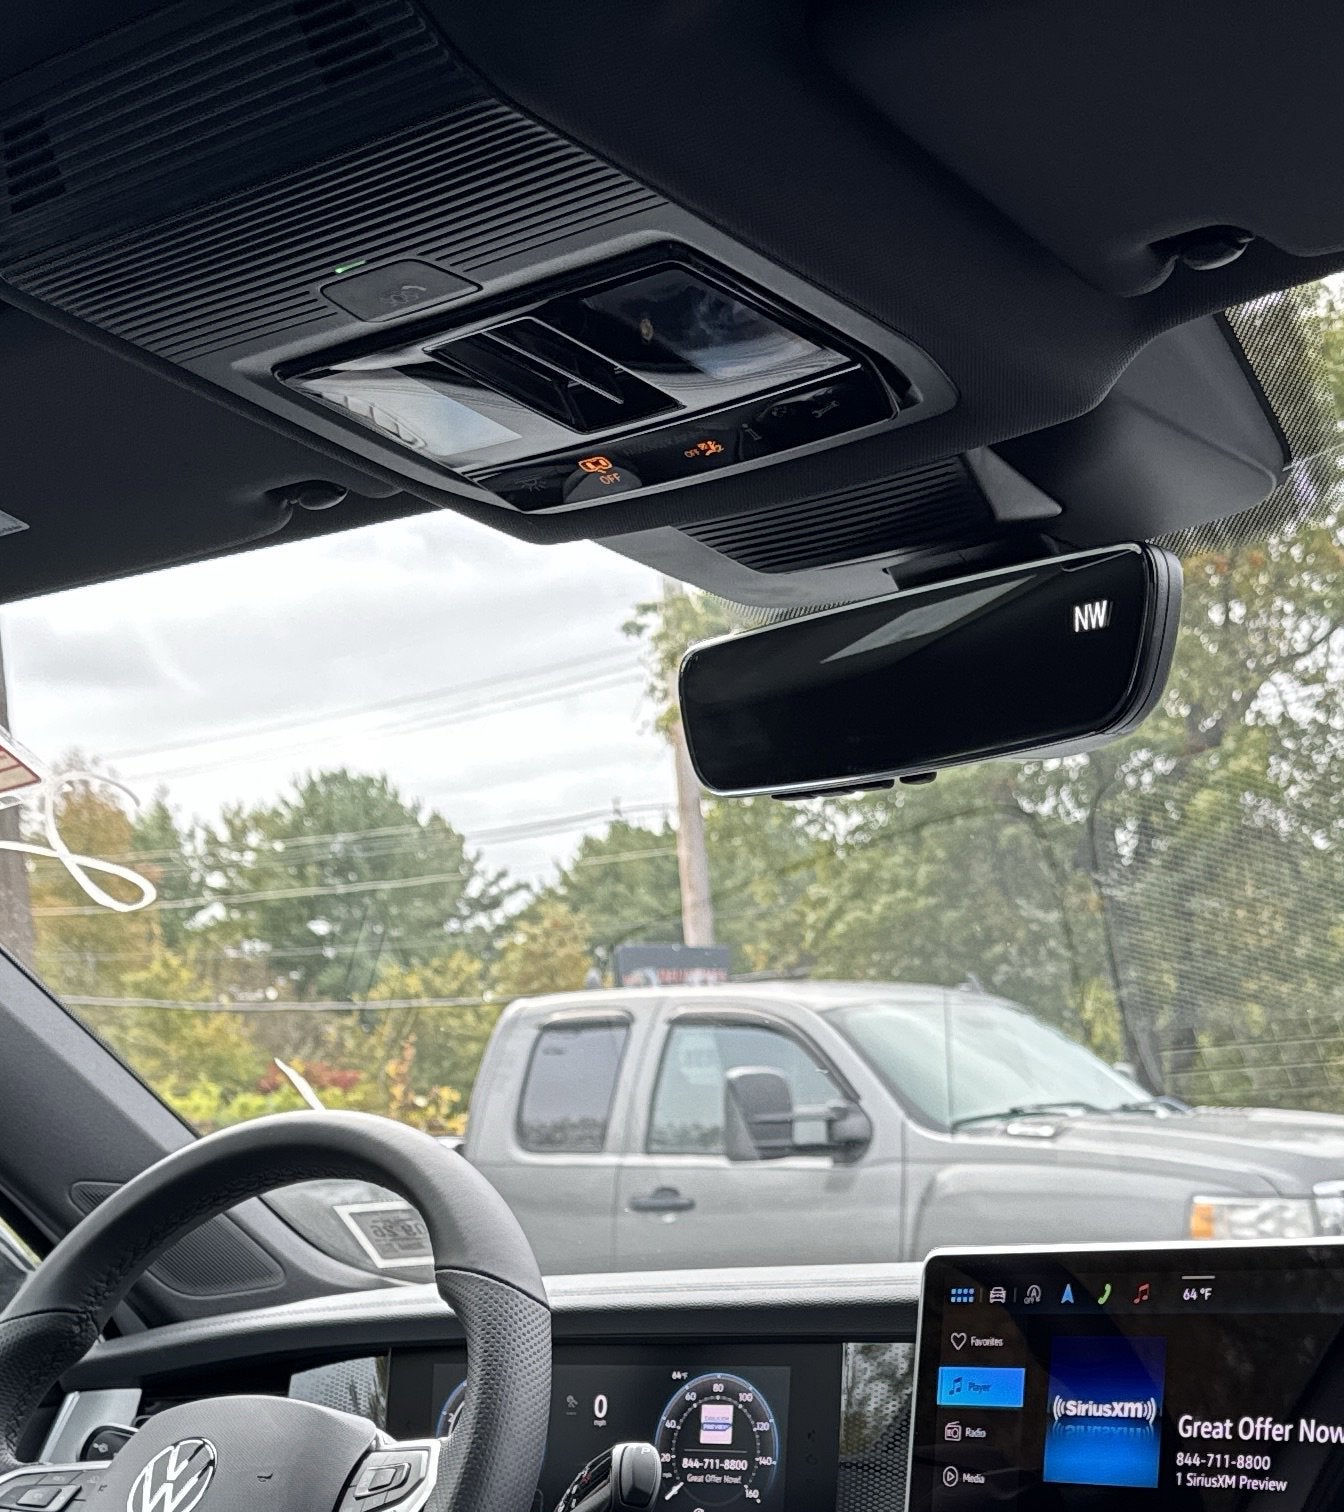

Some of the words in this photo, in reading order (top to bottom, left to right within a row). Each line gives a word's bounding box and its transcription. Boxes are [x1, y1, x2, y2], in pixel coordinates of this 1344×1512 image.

[599, 472, 621, 485] OFF
[1071, 601, 1111, 634] NW
[970, 1336, 1004, 1347] Favorites
[712, 1383, 725, 1393] 80
[968, 1382, 991, 1393] Player
[684, 1391, 697, 1402] 60
[594, 1394, 608, 1419] 0
[965, 1427, 986, 1438] Radio
[1178, 1414, 1233, 1439] Great
[1238, 1416, 1294, 1441] Offer
[681, 1456, 749, 1472] 844-711-8800
[1175, 1452, 1271, 1470] 844-711-8800
[962, 1473, 985, 1484] Media
[1175, 1471, 1182, 1486] 1
[1186, 1472, 1237, 1489] SiriusXM
[1239, 1475, 1288, 1493] Preview
